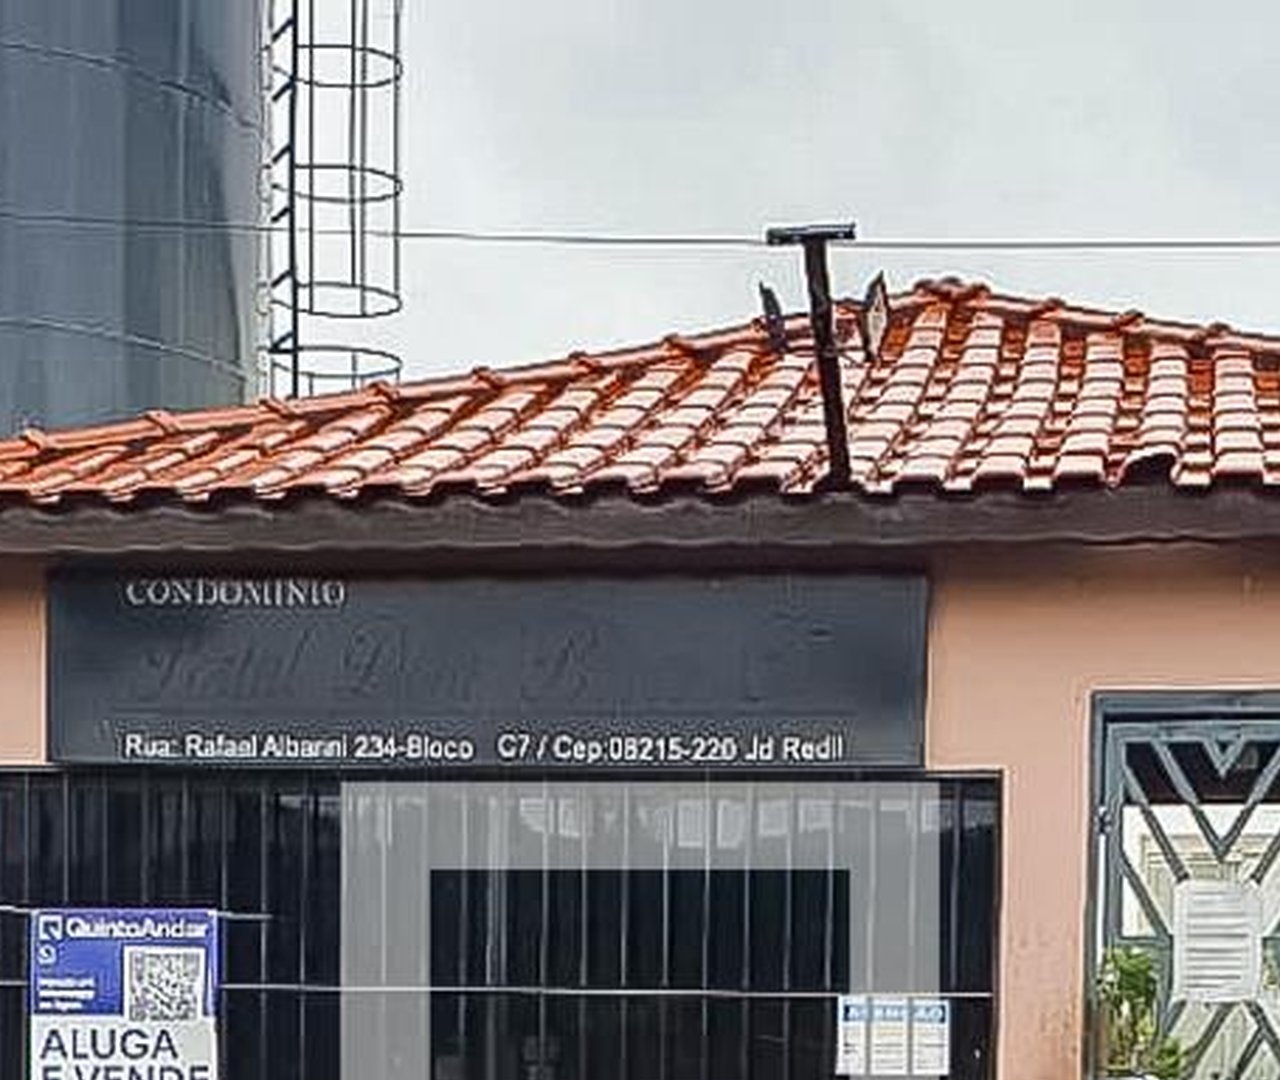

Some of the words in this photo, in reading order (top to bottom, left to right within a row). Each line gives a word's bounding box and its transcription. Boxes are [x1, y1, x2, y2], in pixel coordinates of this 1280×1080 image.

[125, 579, 345, 606] CONDOMINIO
[185, 733, 257, 758] Rafael
[40, 1029, 178, 1060] ALUGA
